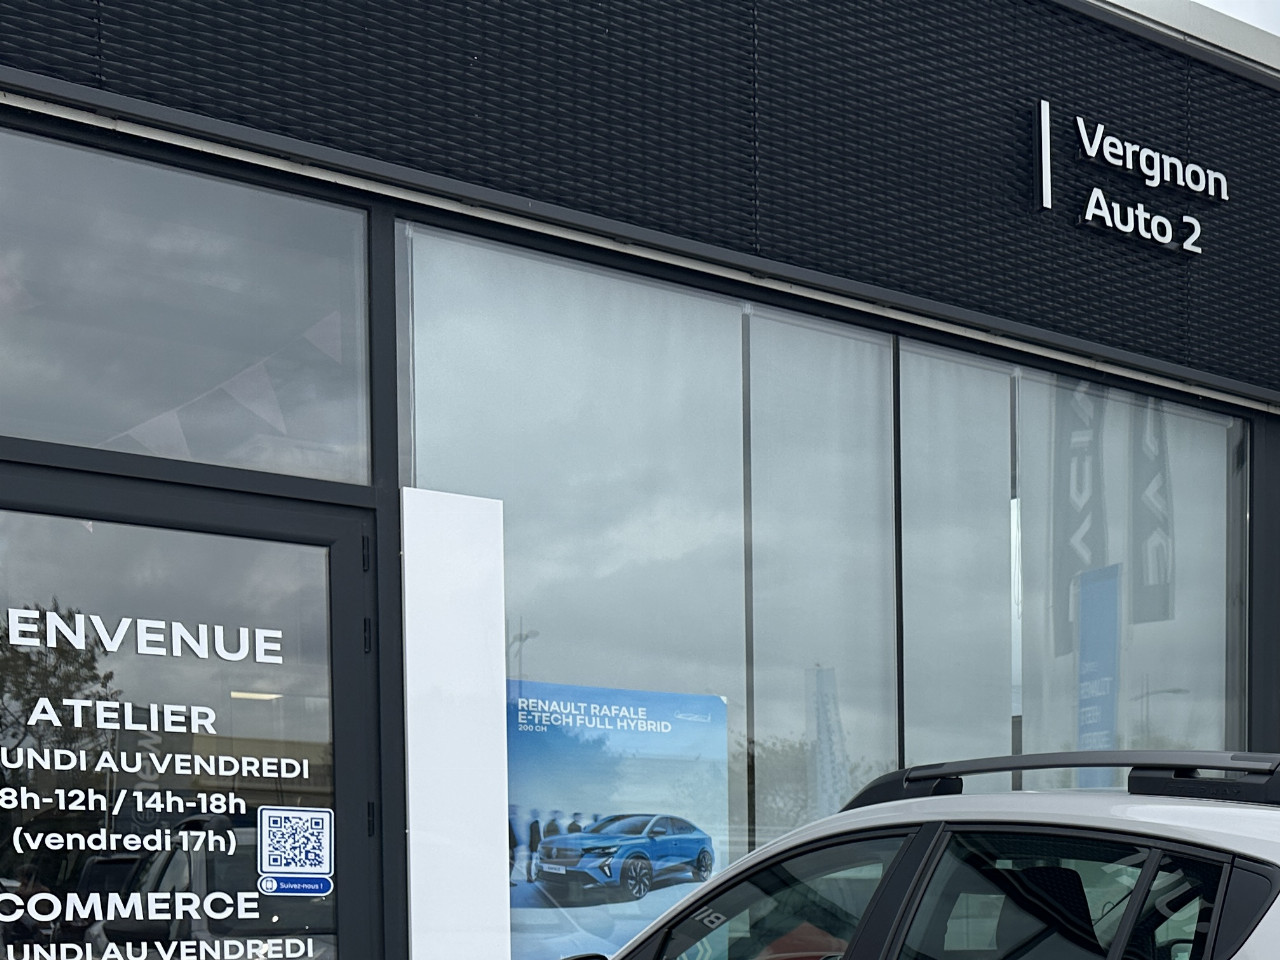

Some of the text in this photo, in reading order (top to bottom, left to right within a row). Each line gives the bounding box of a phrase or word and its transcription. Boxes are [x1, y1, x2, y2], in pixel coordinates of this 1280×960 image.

[1076, 116, 1229, 201] Vergnon
[1085, 187, 1202, 254] Auto 2
[8, 608, 283, 664] ENVENUE
[27, 697, 217, 734] ATELIER
[518, 698, 647, 719] RENAULT RAFALE
[518, 711, 672, 733] E-TECH FULL HYBRID
[518, 724, 533, 732] 200
[0, 747, 309, 779] UNDI AU VENDREDI
[0, 787, 247, 816] 8h-12h / 14h-18h
[12, 826, 237, 856] (vendredi 17h)
[0, 891, 260, 922] COMMERCE
